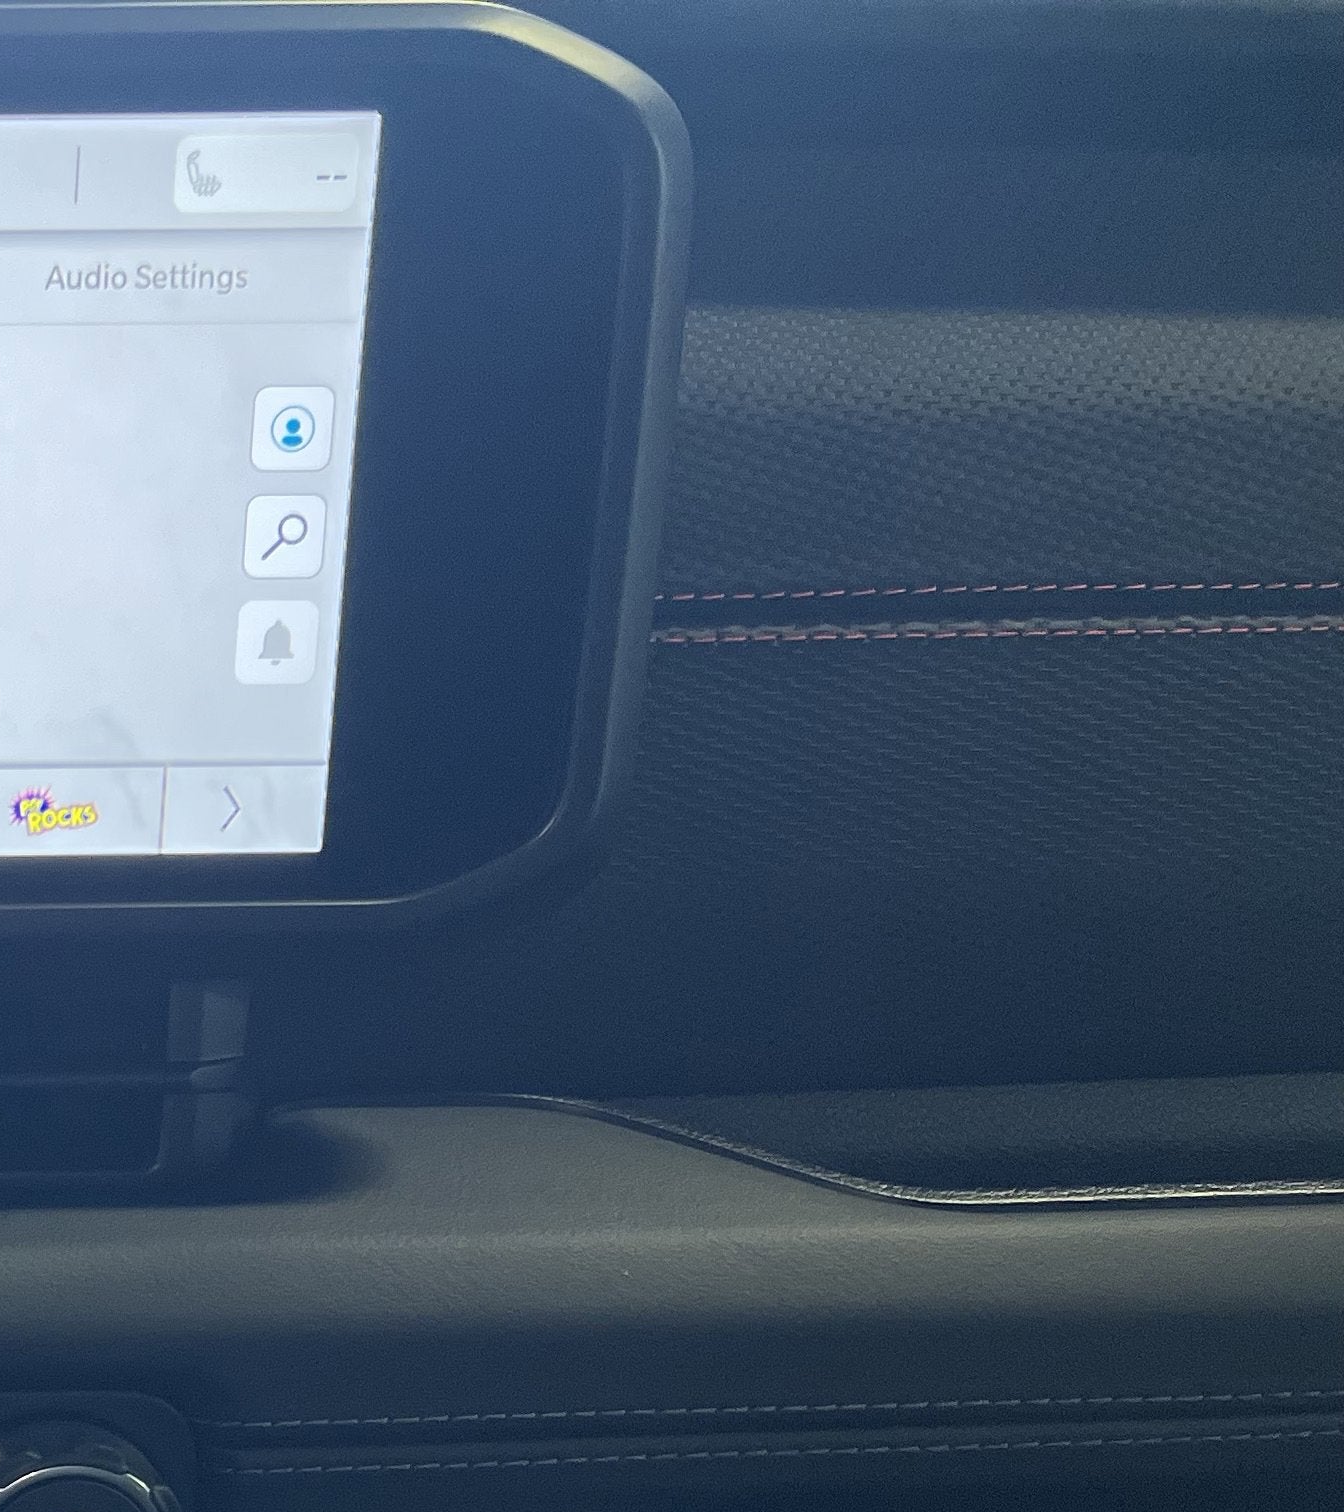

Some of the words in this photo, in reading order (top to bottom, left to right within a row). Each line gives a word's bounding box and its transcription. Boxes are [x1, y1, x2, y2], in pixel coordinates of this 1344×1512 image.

[44, 265, 128, 292] Audio
[134, 263, 249, 295] Settings
[27, 804, 96, 833] ROCKS
